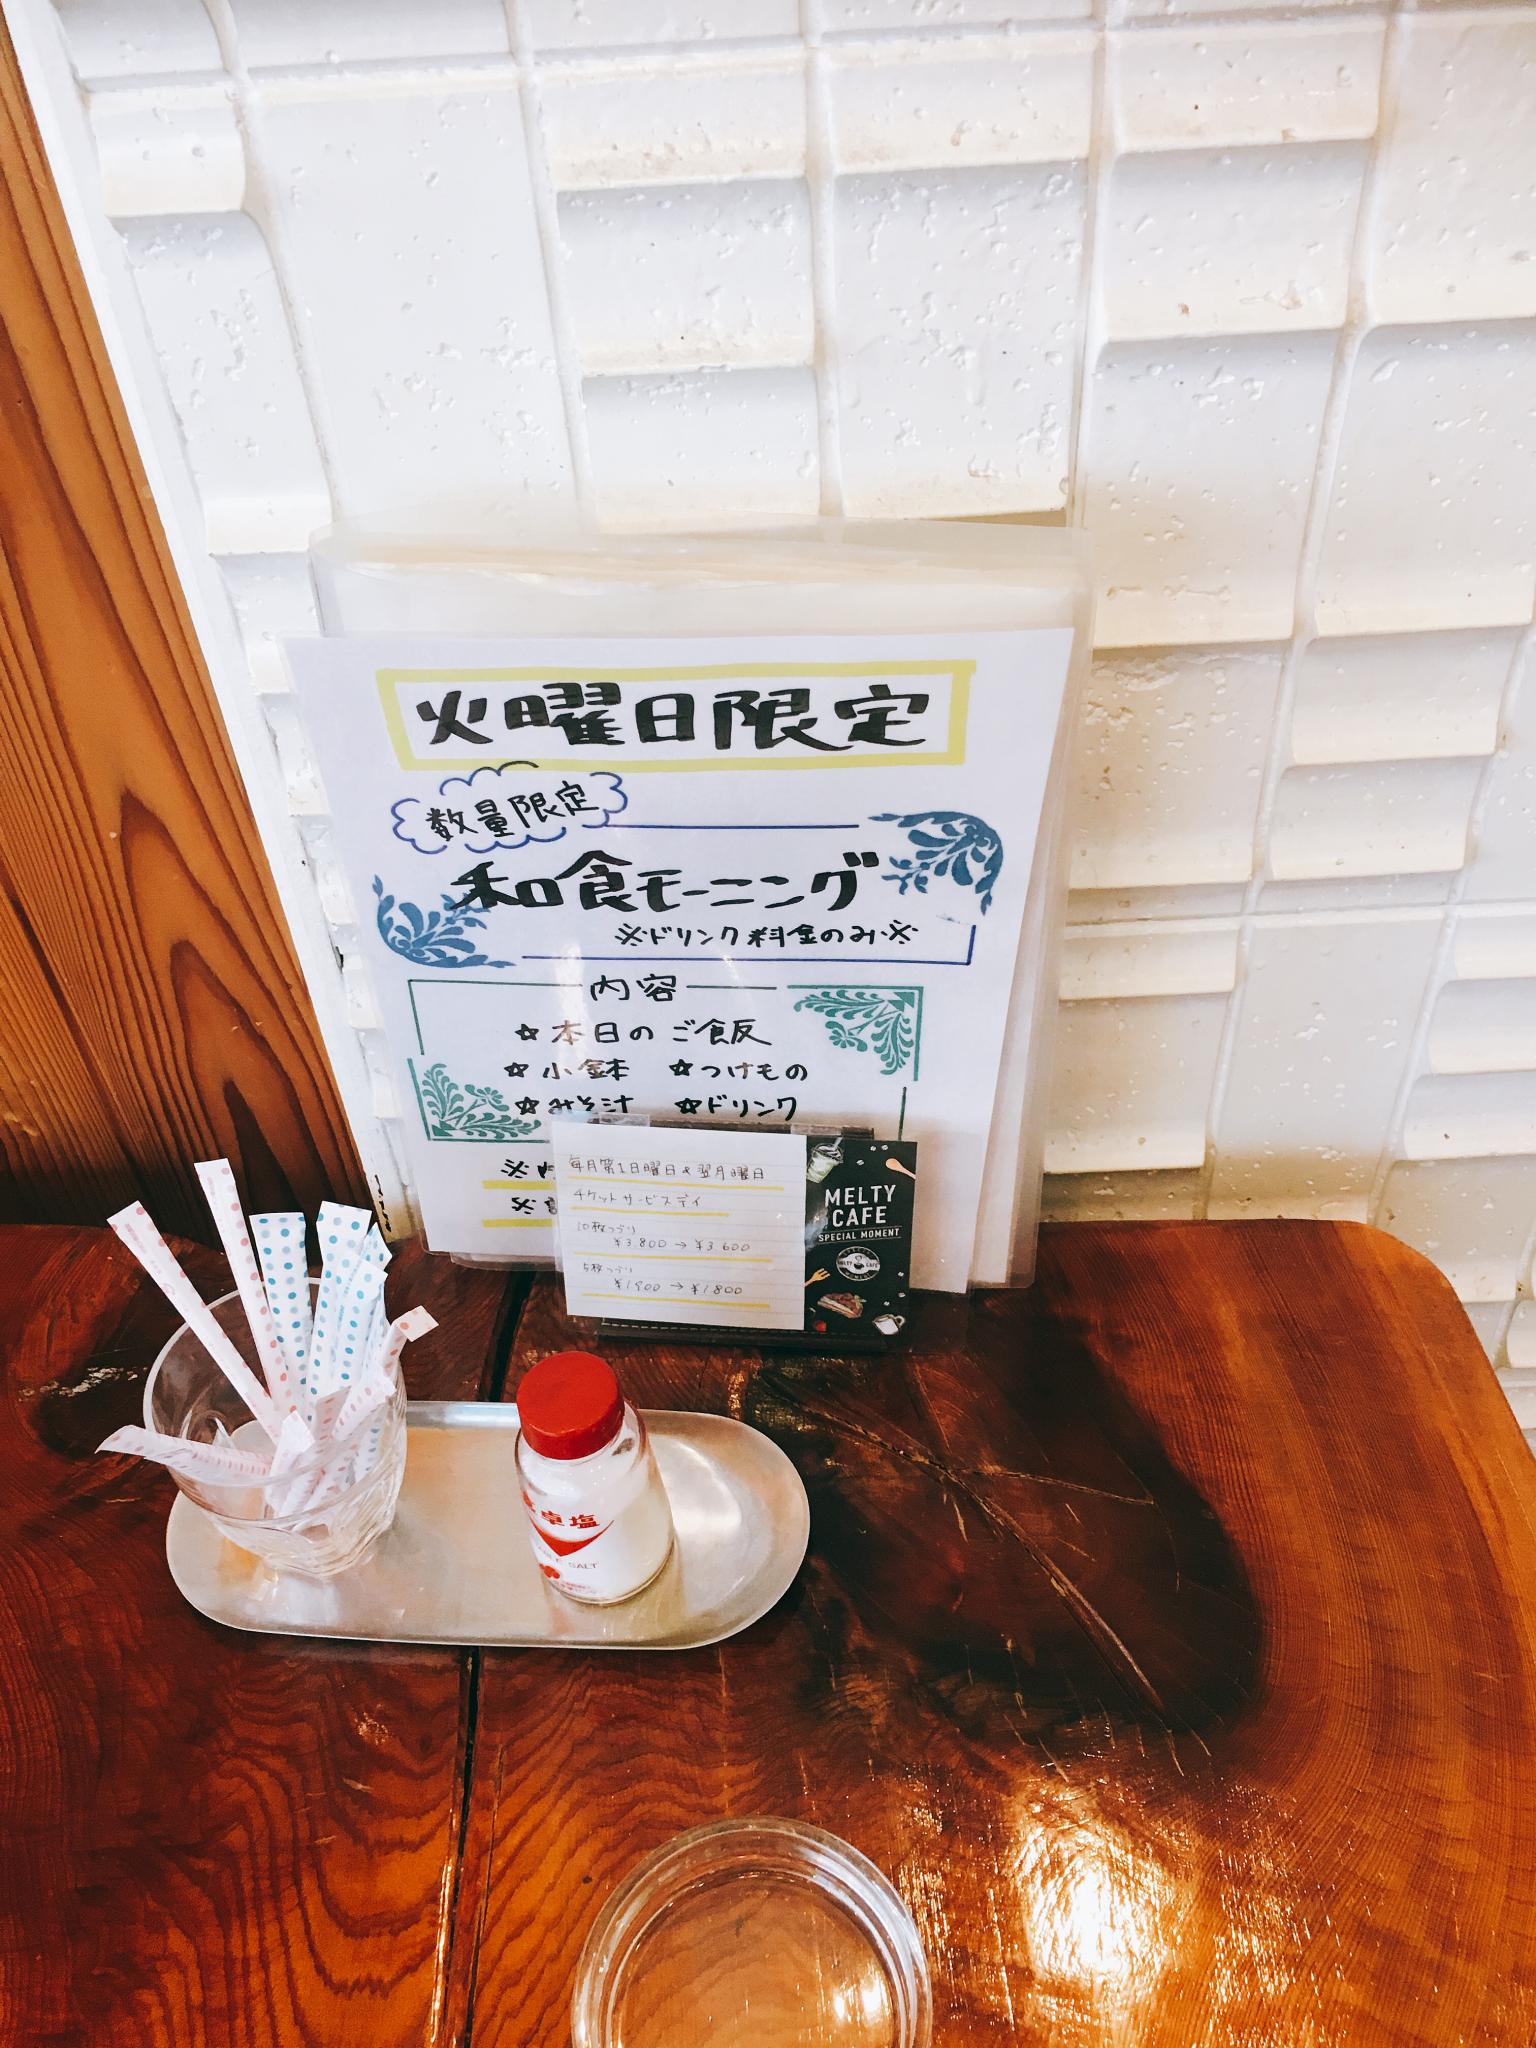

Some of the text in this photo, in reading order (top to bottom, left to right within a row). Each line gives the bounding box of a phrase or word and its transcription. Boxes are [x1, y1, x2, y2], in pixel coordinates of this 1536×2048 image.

[416, 682, 931, 751] 火曜日限定
[426, 781, 602, 840] 数量限定
[450, 850, 880, 914] 和食モーニング
[589, 974, 678, 1002] 内容
[825, 1184, 896, 1207] MELTY
[832, 1206, 887, 1228] CAFE
[818, 1227, 900, 1243] SPECIAL MOMENT
